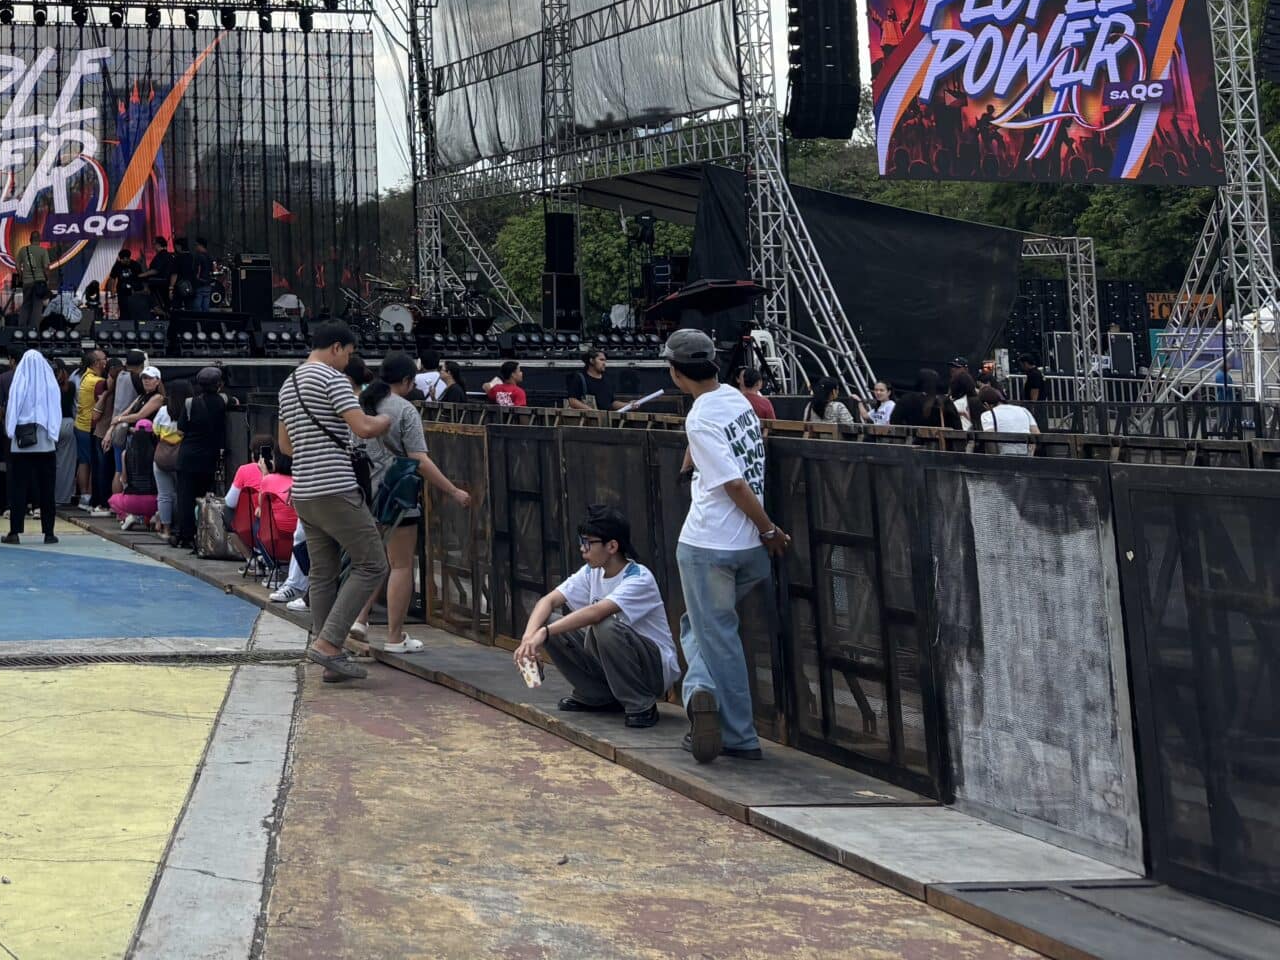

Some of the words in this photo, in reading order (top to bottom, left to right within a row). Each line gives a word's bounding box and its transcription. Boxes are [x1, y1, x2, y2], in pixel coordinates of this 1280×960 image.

[919, 13, 1136, 100] POWER
[1109, 90, 1130, 100] SA
[1131, 83, 1164, 101] QC
[52, 223, 80, 235] SA
[83, 214, 130, 236] QC
[724, 422, 737, 441] IF
